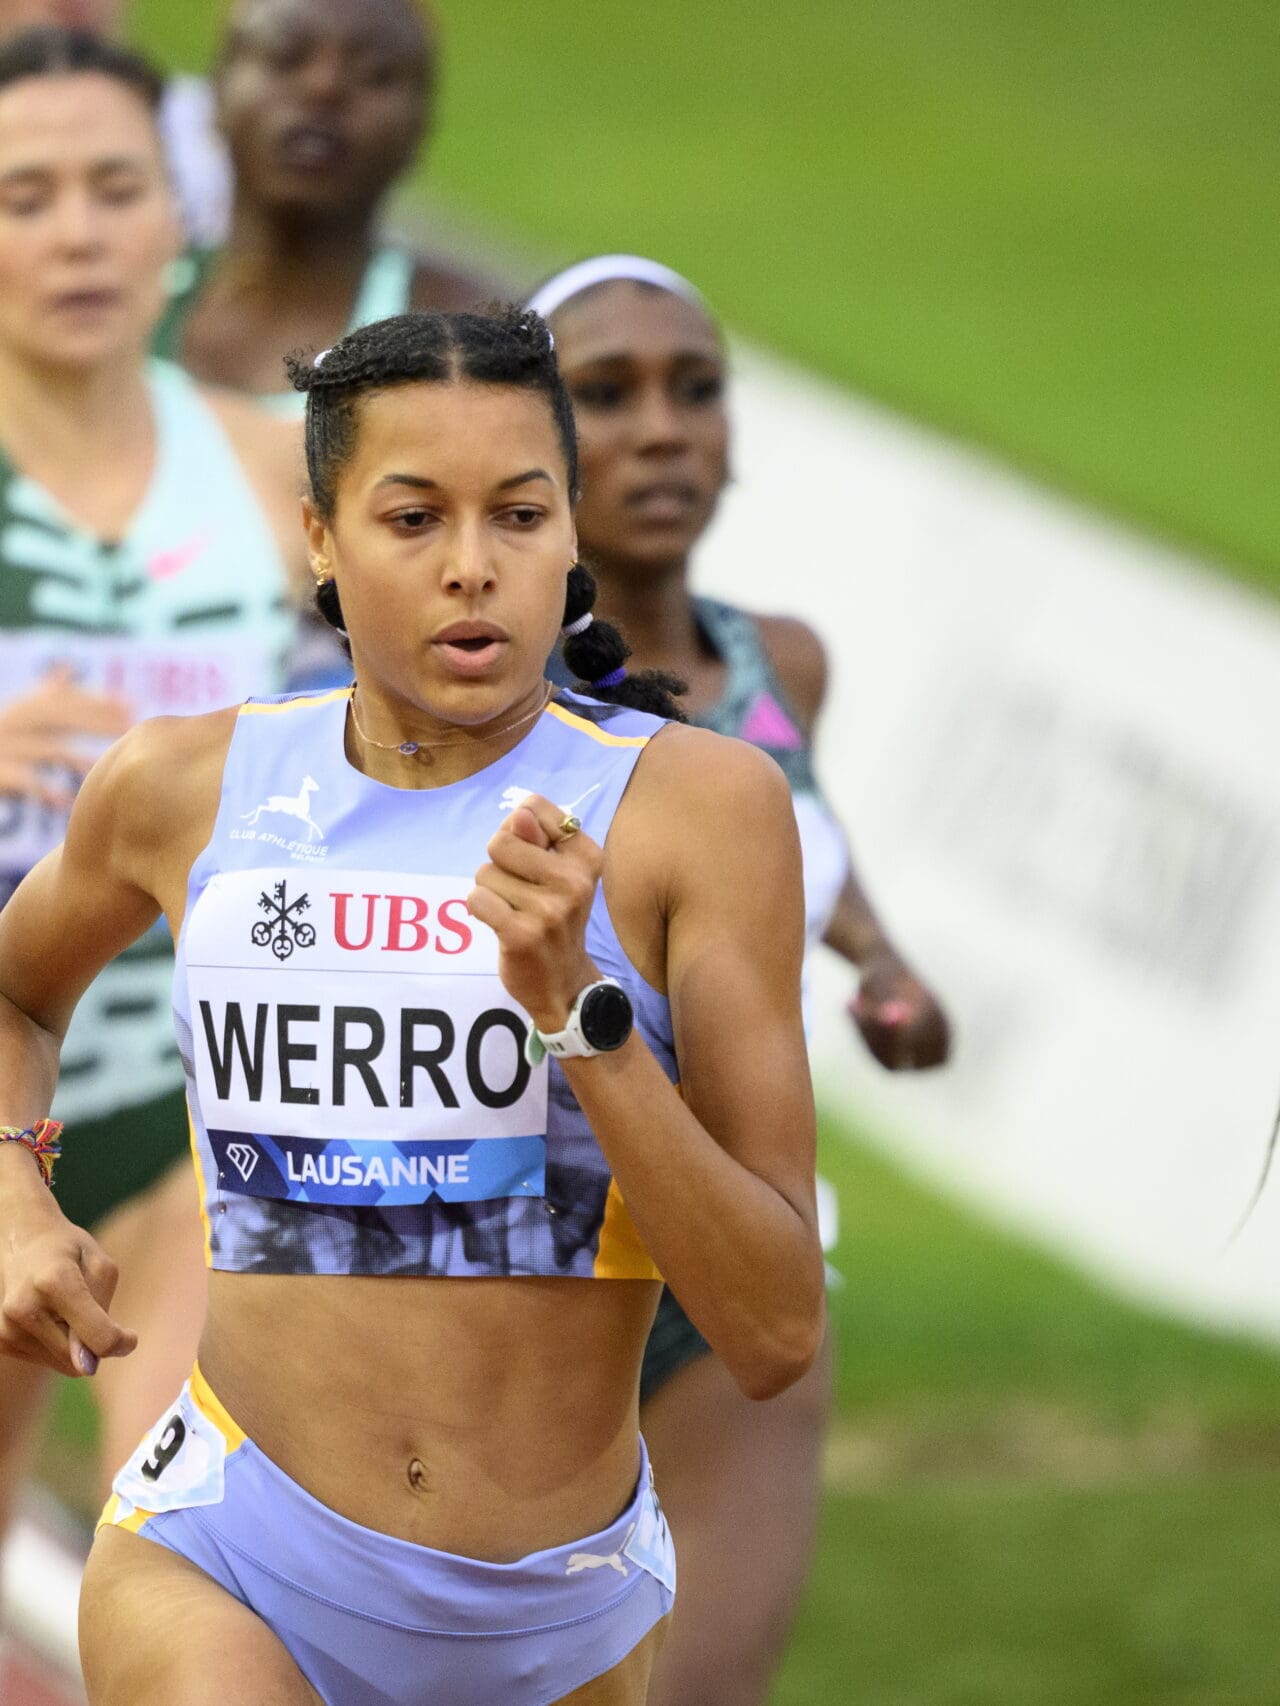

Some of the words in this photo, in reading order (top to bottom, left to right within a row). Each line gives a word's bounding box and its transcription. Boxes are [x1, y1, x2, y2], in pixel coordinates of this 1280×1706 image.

[229, 829, 257, 840] CLUB
[329, 893, 473, 955] UBS
[199, 1000, 532, 1109] WERRO
[286, 1151, 469, 1187] LAUSANNE
[141, 1414, 186, 1481] 9
